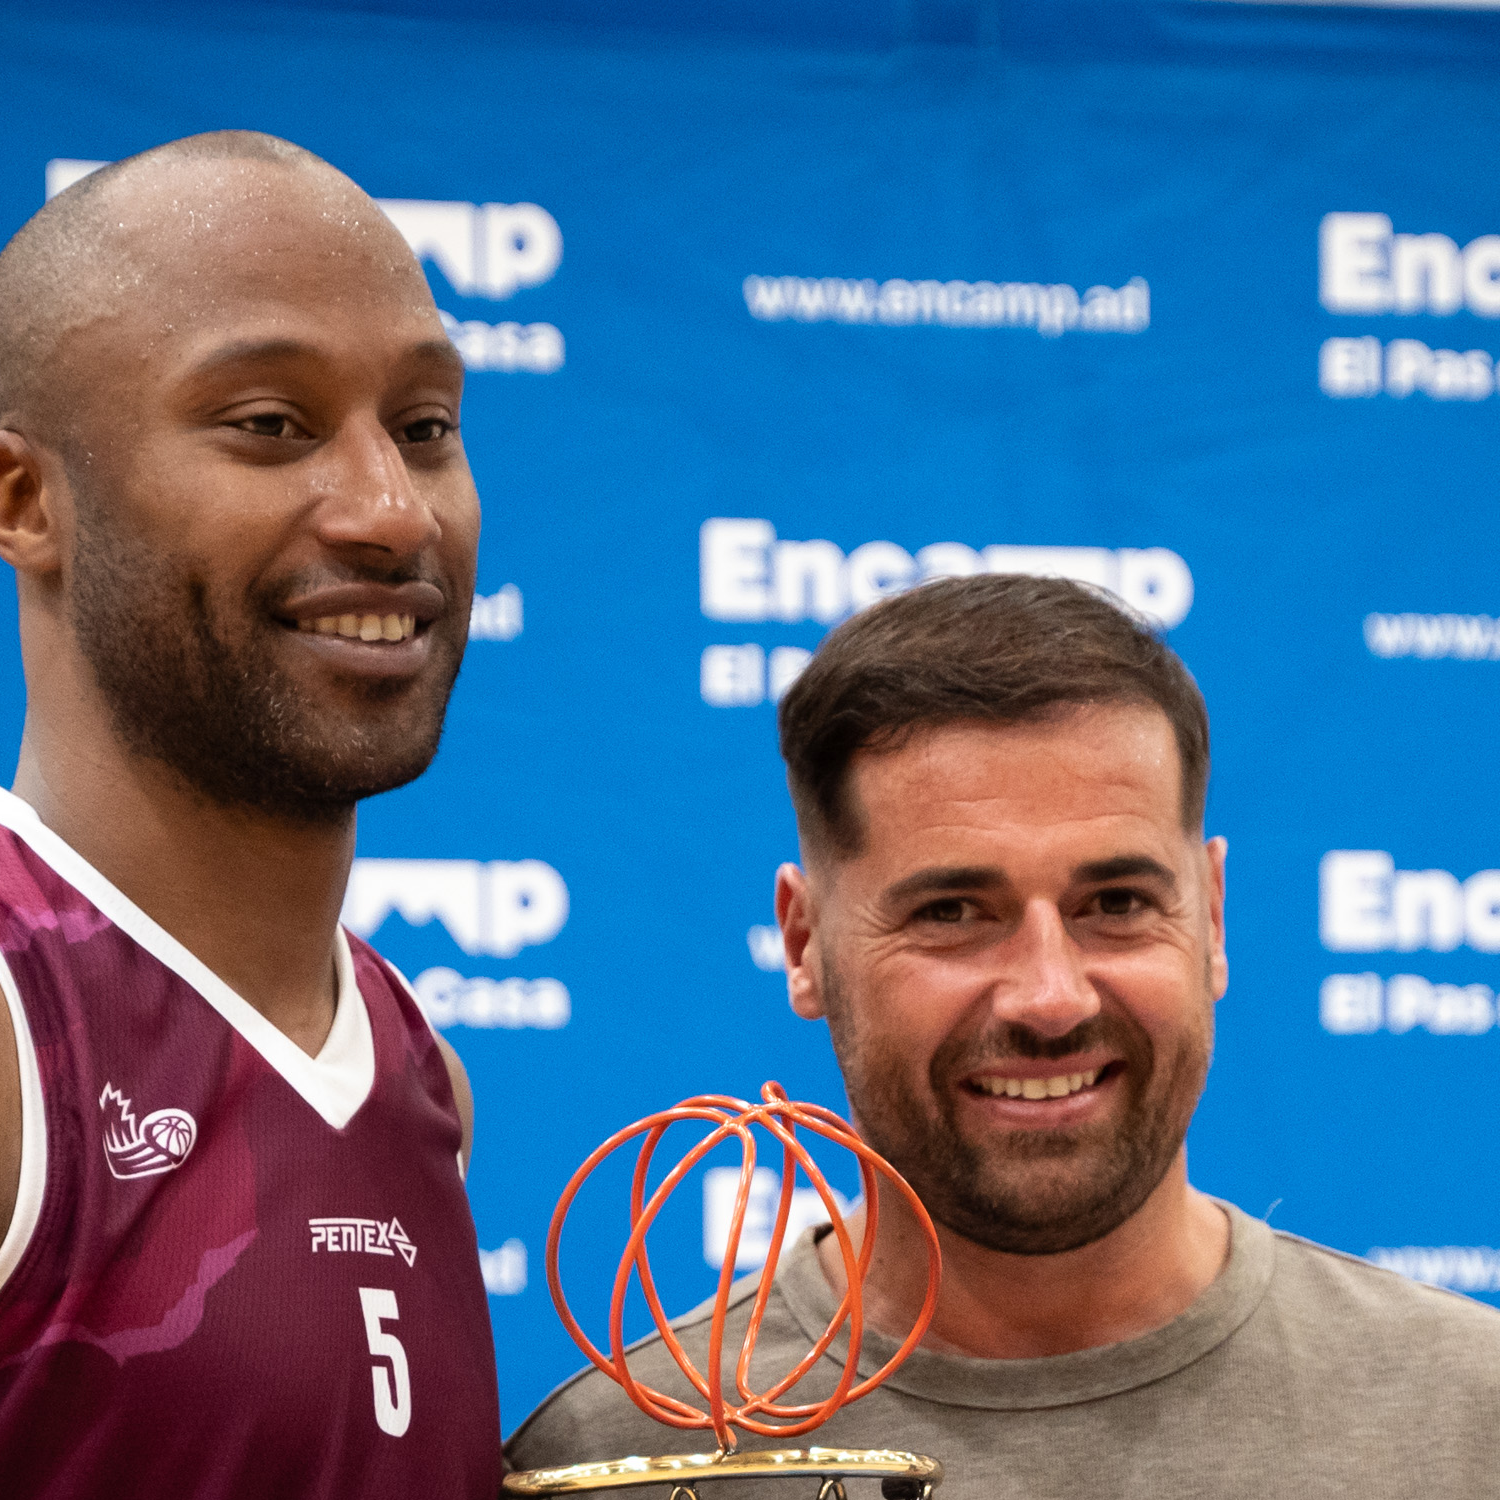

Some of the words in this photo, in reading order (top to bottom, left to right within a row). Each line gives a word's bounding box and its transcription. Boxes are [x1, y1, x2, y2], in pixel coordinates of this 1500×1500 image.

[744, 276, 1150, 334] www.encamp.ad
[438, 310, 566, 374] asa
[1320, 336, 1382, 396] El
[1385, 339, 1493, 399] Pas
[700, 518, 1194, 632] Encp
[701, 643, 766, 707] El
[1320, 972, 1383, 1034] El
[1386, 974, 1494, 1034] Pas
[308, 1217, 395, 1256] PENTEX
[358, 1287, 412, 1438] 5
